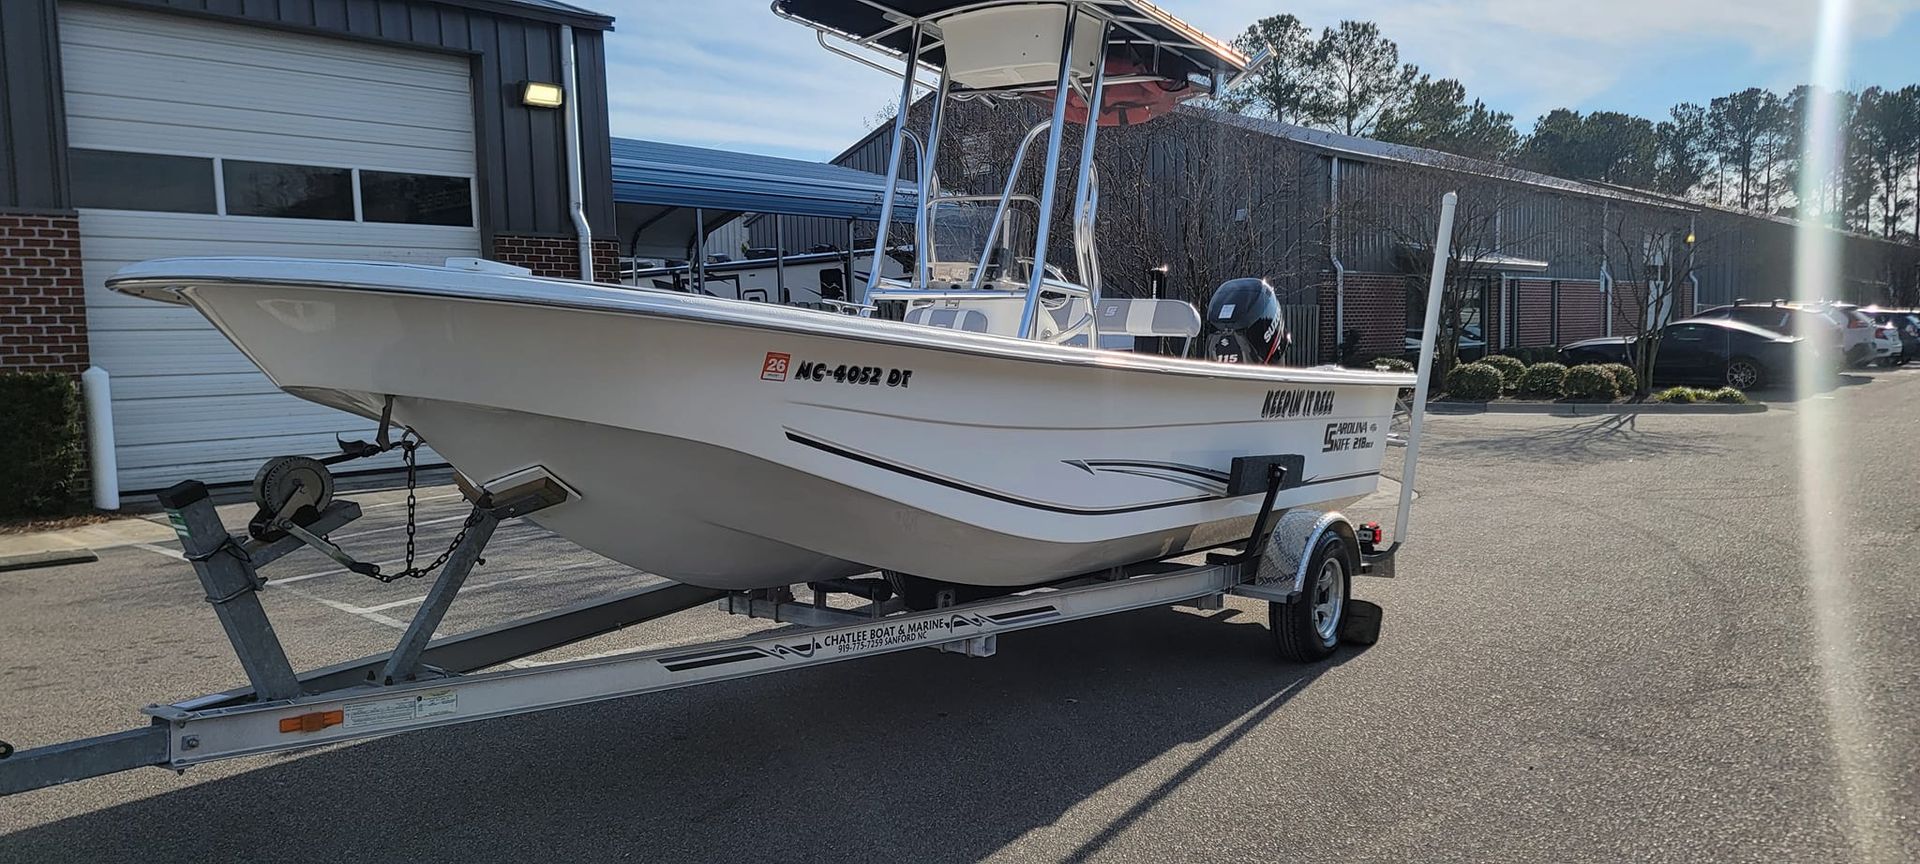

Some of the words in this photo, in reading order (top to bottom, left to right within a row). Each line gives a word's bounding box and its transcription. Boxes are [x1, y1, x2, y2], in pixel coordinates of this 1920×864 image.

[767, 358, 786, 372] 26
[1218, 354, 1238, 363] 115
[795, 360, 883, 386] NC-4052
[886, 368, 912, 388] DT
[1303, 389, 1315, 417] IT
[1313, 390, 1335, 417] REEL
[1324, 421, 1368, 442] CAROLINA
[1322, 433, 1350, 453] SKIFF
[824, 630, 867, 647] CHATLEE
[870, 626, 896, 639] BOAT
[898, 624, 905, 635] &
[908, 618, 944, 633] MARINE
[838, 639, 883, 654] 919-775-7259
[884, 633, 916, 646] SANFORD
[917, 631, 927, 640] NC
